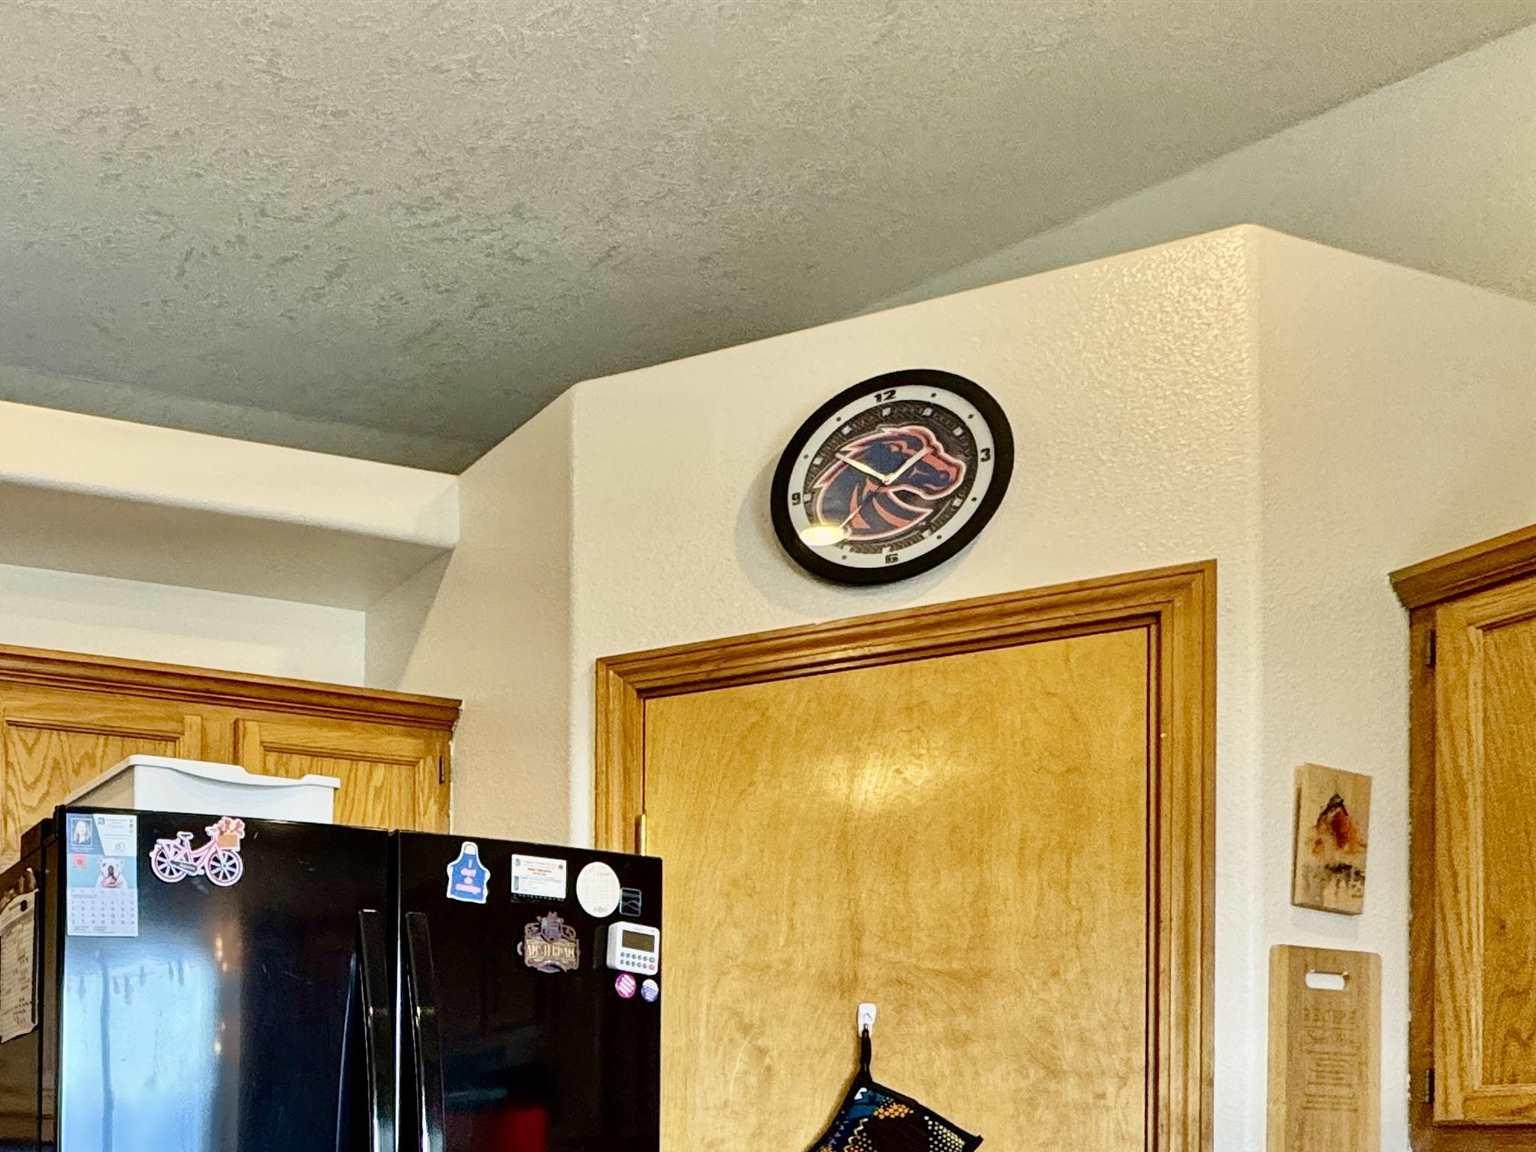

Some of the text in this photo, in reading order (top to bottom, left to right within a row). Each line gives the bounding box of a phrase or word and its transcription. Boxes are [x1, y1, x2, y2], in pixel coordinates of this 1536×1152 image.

[873, 389, 896, 403] 12
[980, 447, 992, 463] 3
[790, 492, 803, 506] 9
[884, 553, 900, 565] 6
